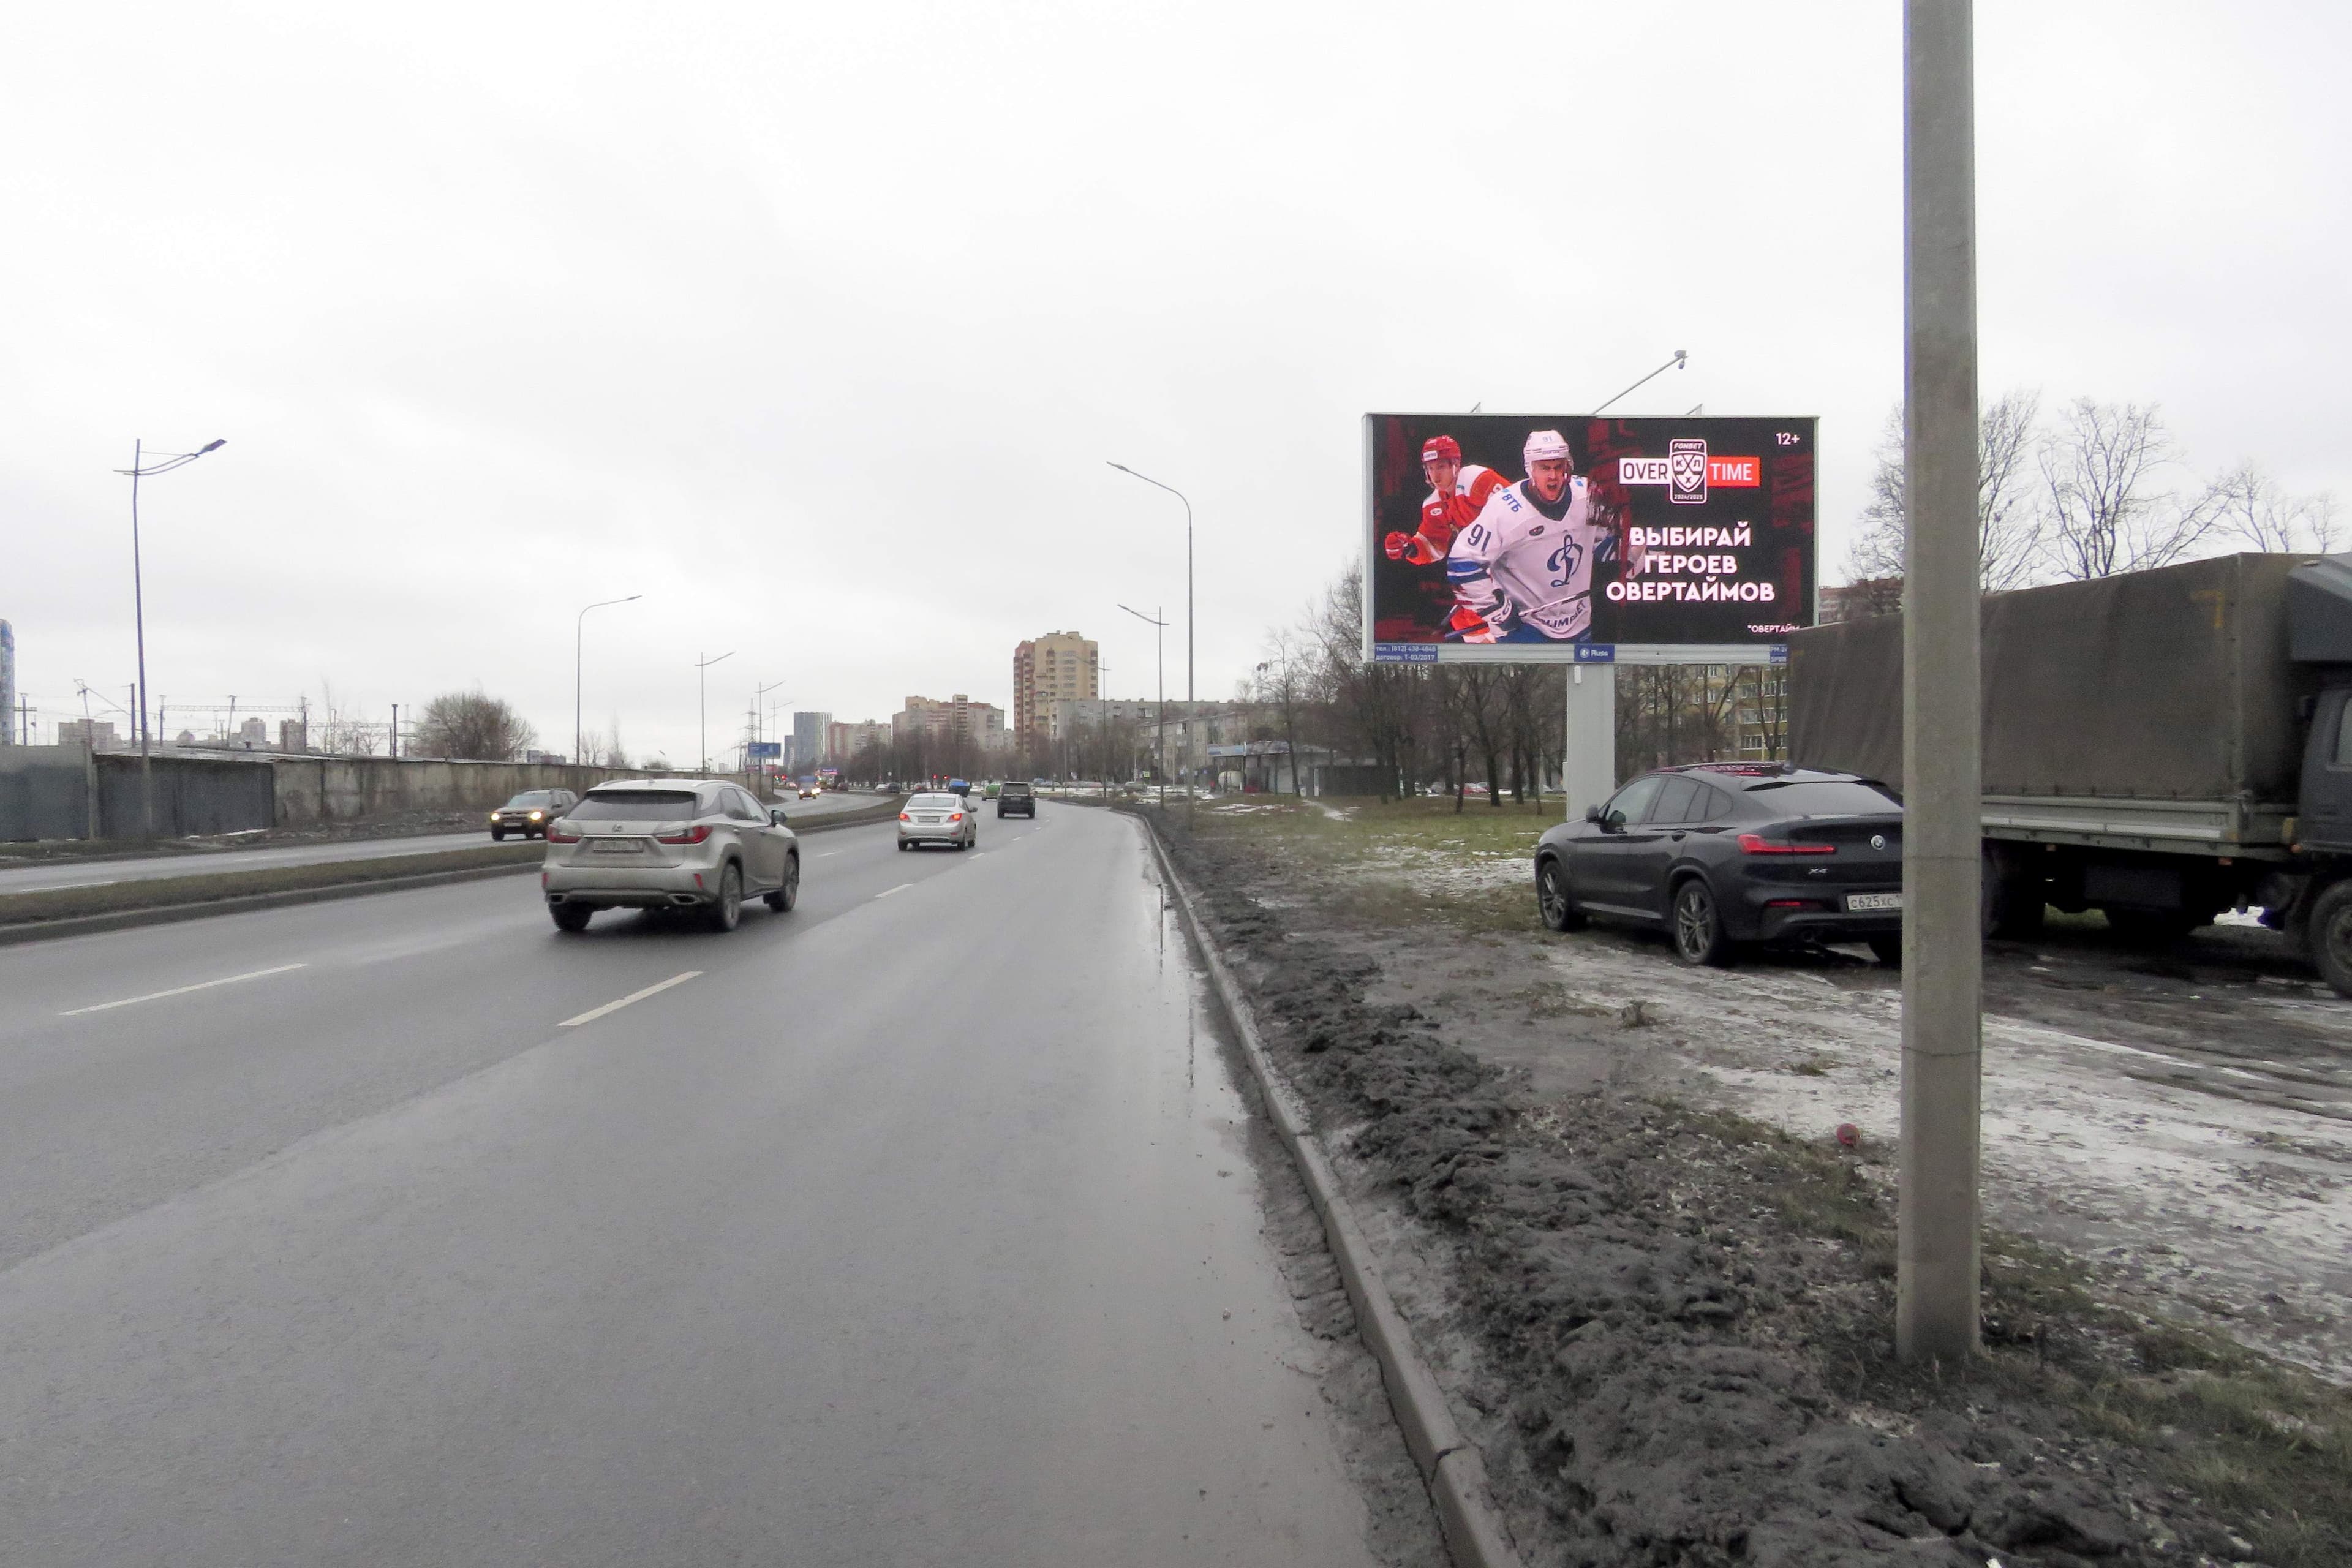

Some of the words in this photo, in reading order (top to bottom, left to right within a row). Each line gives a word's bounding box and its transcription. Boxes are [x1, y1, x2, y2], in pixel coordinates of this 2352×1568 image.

[1776, 432, 1800, 445] 12+
[1623, 462, 1668, 480] OVER
[1710, 463, 1752, 481] TIME
[1502, 493, 1523, 513] ВТБ
[1467, 524, 1492, 553] 91
[1630, 521, 1751, 546] ВЫБИРАЙ
[1644, 554, 1738, 574] ГЕРОЕВ
[1606, 576, 1776, 601] ОВЕРТАЙМОВ
